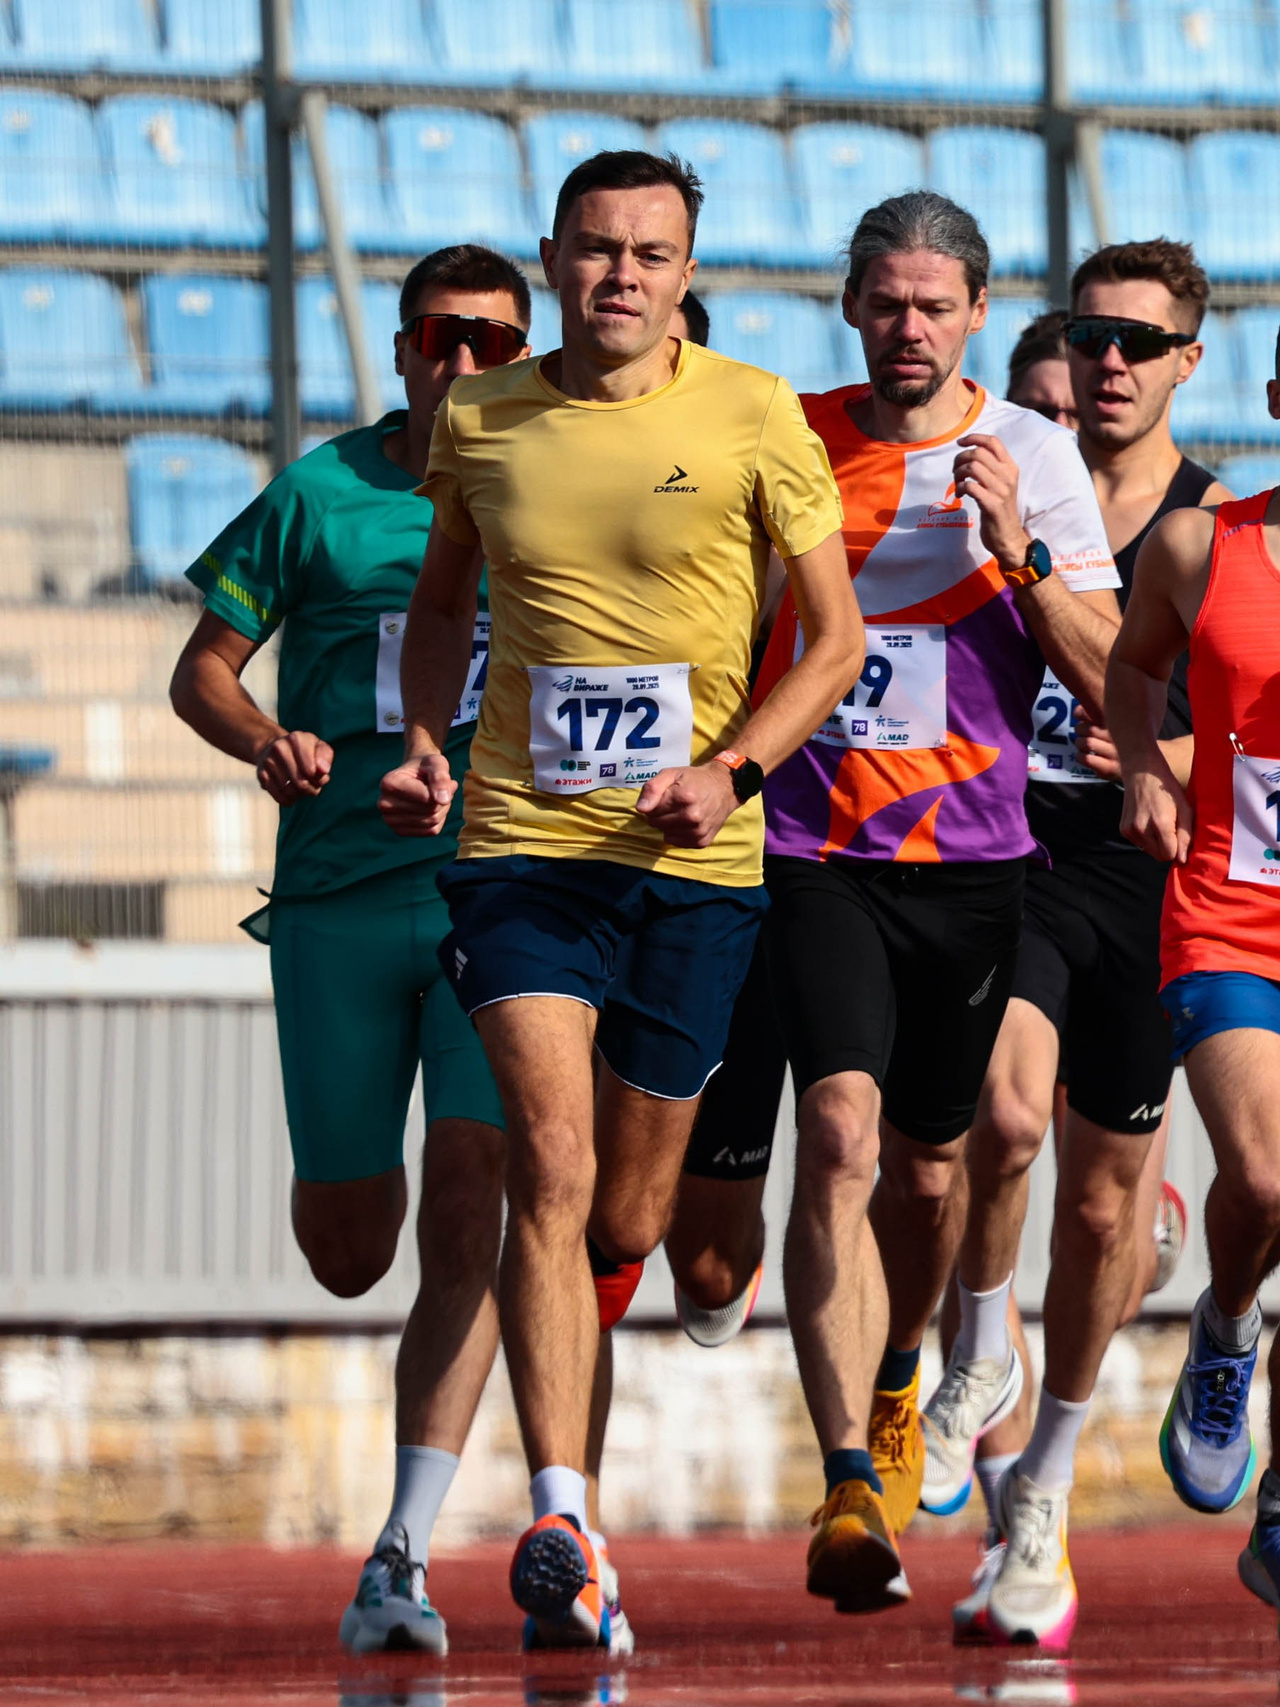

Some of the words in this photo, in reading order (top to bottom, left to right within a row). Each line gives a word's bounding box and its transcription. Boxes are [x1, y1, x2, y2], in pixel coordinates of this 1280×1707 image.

[557, 696, 661, 751] 172
[854, 722, 866, 733] 78
[602, 766, 615, 775] 78
